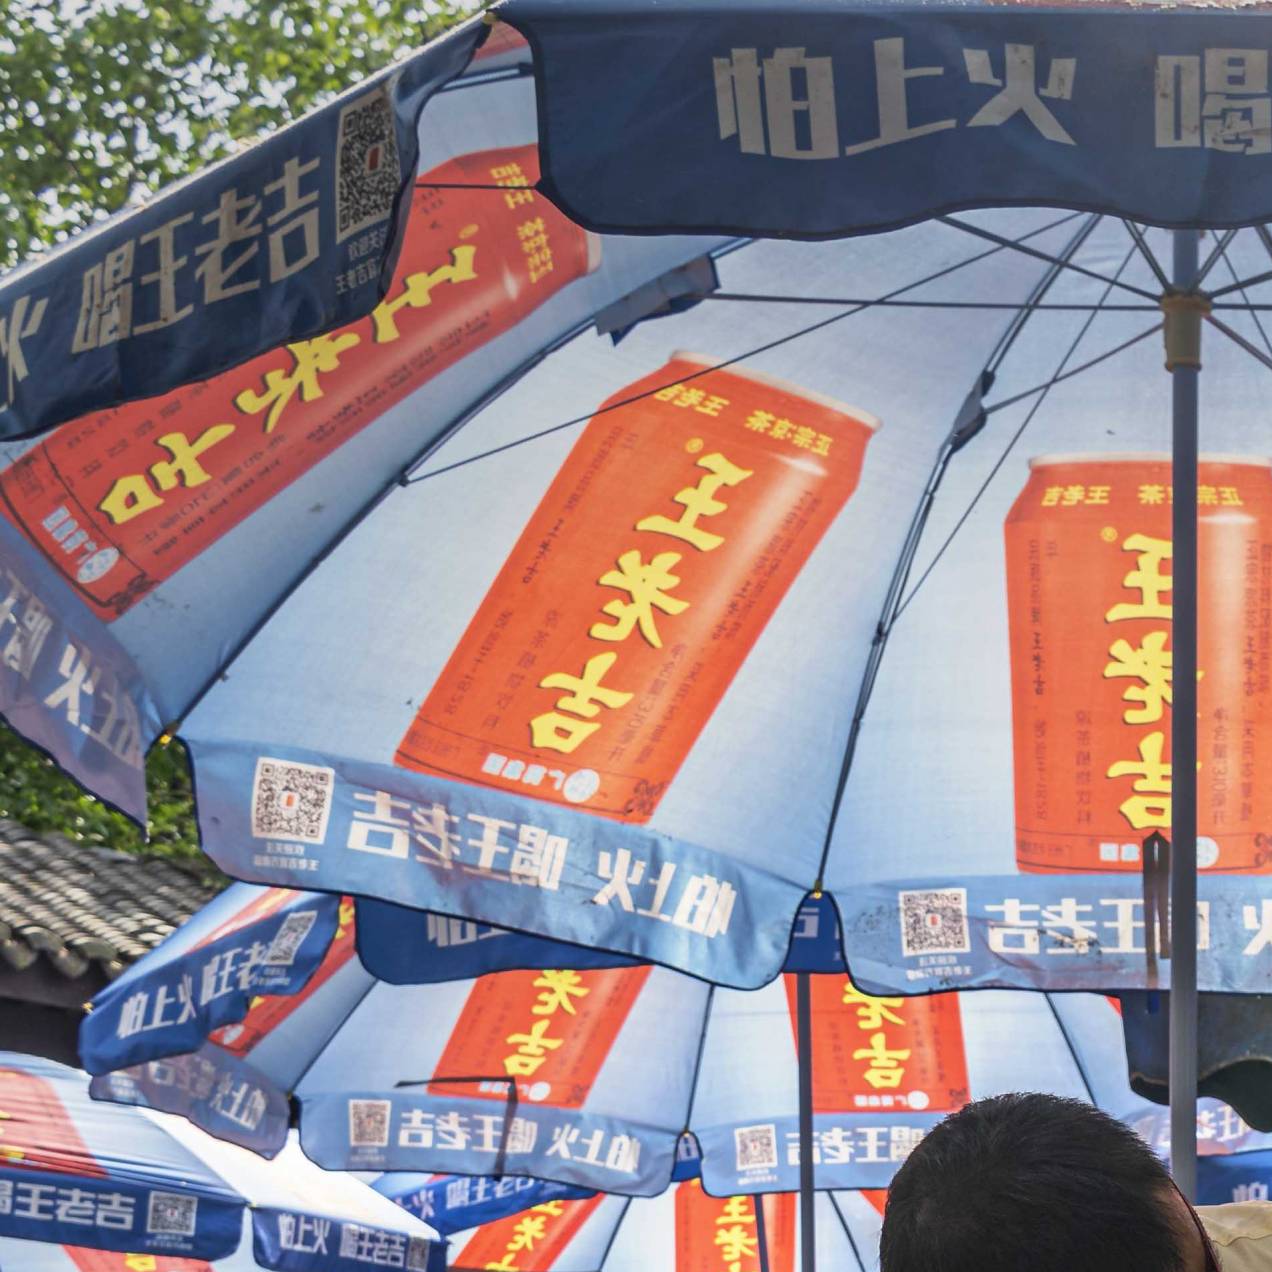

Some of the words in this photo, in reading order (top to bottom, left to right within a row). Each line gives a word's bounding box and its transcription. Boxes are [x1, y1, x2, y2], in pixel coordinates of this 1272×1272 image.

[713, 36, 1077, 160] 怕上火
[72, 155, 321, 355] 喝王老吉
[116, 972, 197, 1041] 怕上火
[277, 1212, 332, 1254] 怕上火
[338, 1222, 407, 1266] 喝王老吉
